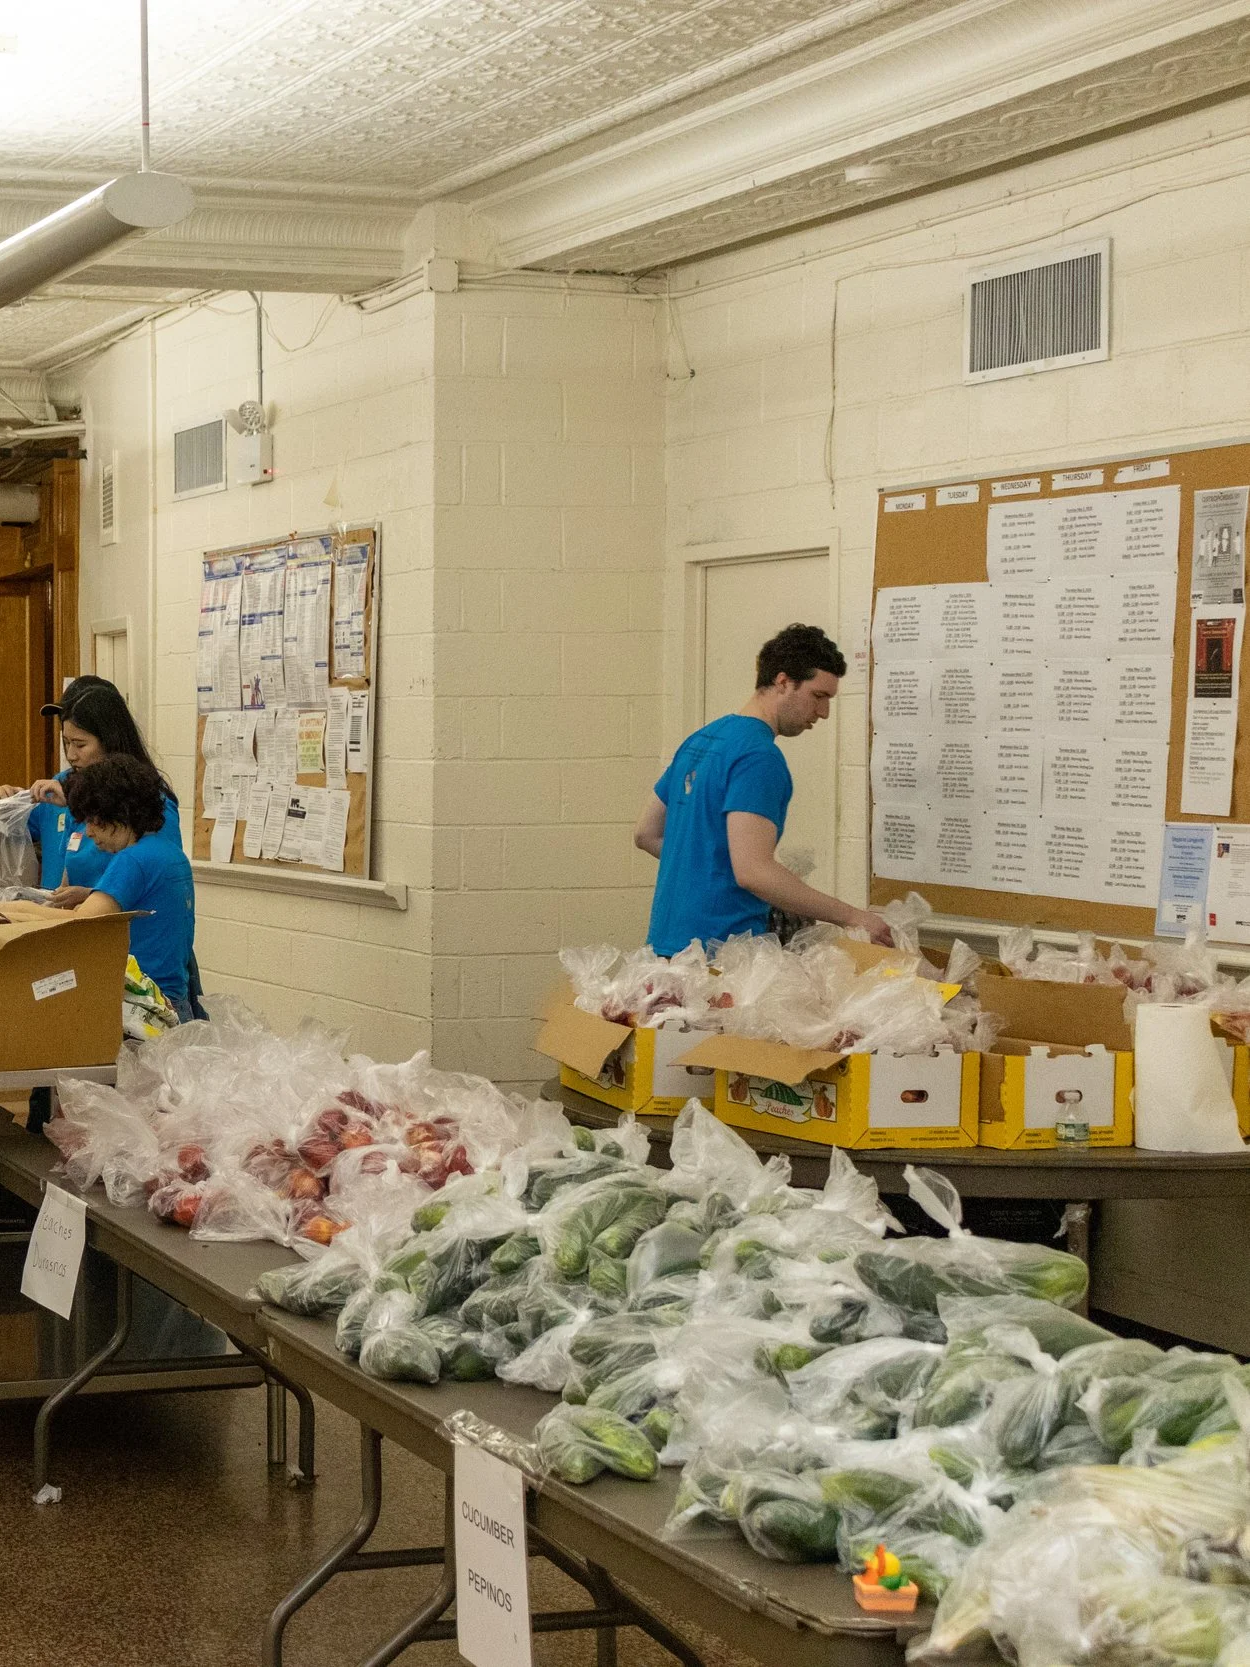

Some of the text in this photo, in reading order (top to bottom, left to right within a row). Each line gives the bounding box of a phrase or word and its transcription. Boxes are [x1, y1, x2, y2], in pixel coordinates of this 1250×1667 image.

[1133, 463, 1151, 473] FRIDAY
[1062, 472, 1093, 481] THURSDAY
[1000, 480, 1032, 491] WEDNESDAY
[947, 490, 969, 499] TUESDAY
[895, 502, 914, 510] MONDAY
[765, 1101, 795, 1117] Peaches
[461, 1500, 516, 1549] CUCUMBER
[467, 1568, 513, 1613] PEPINOS
